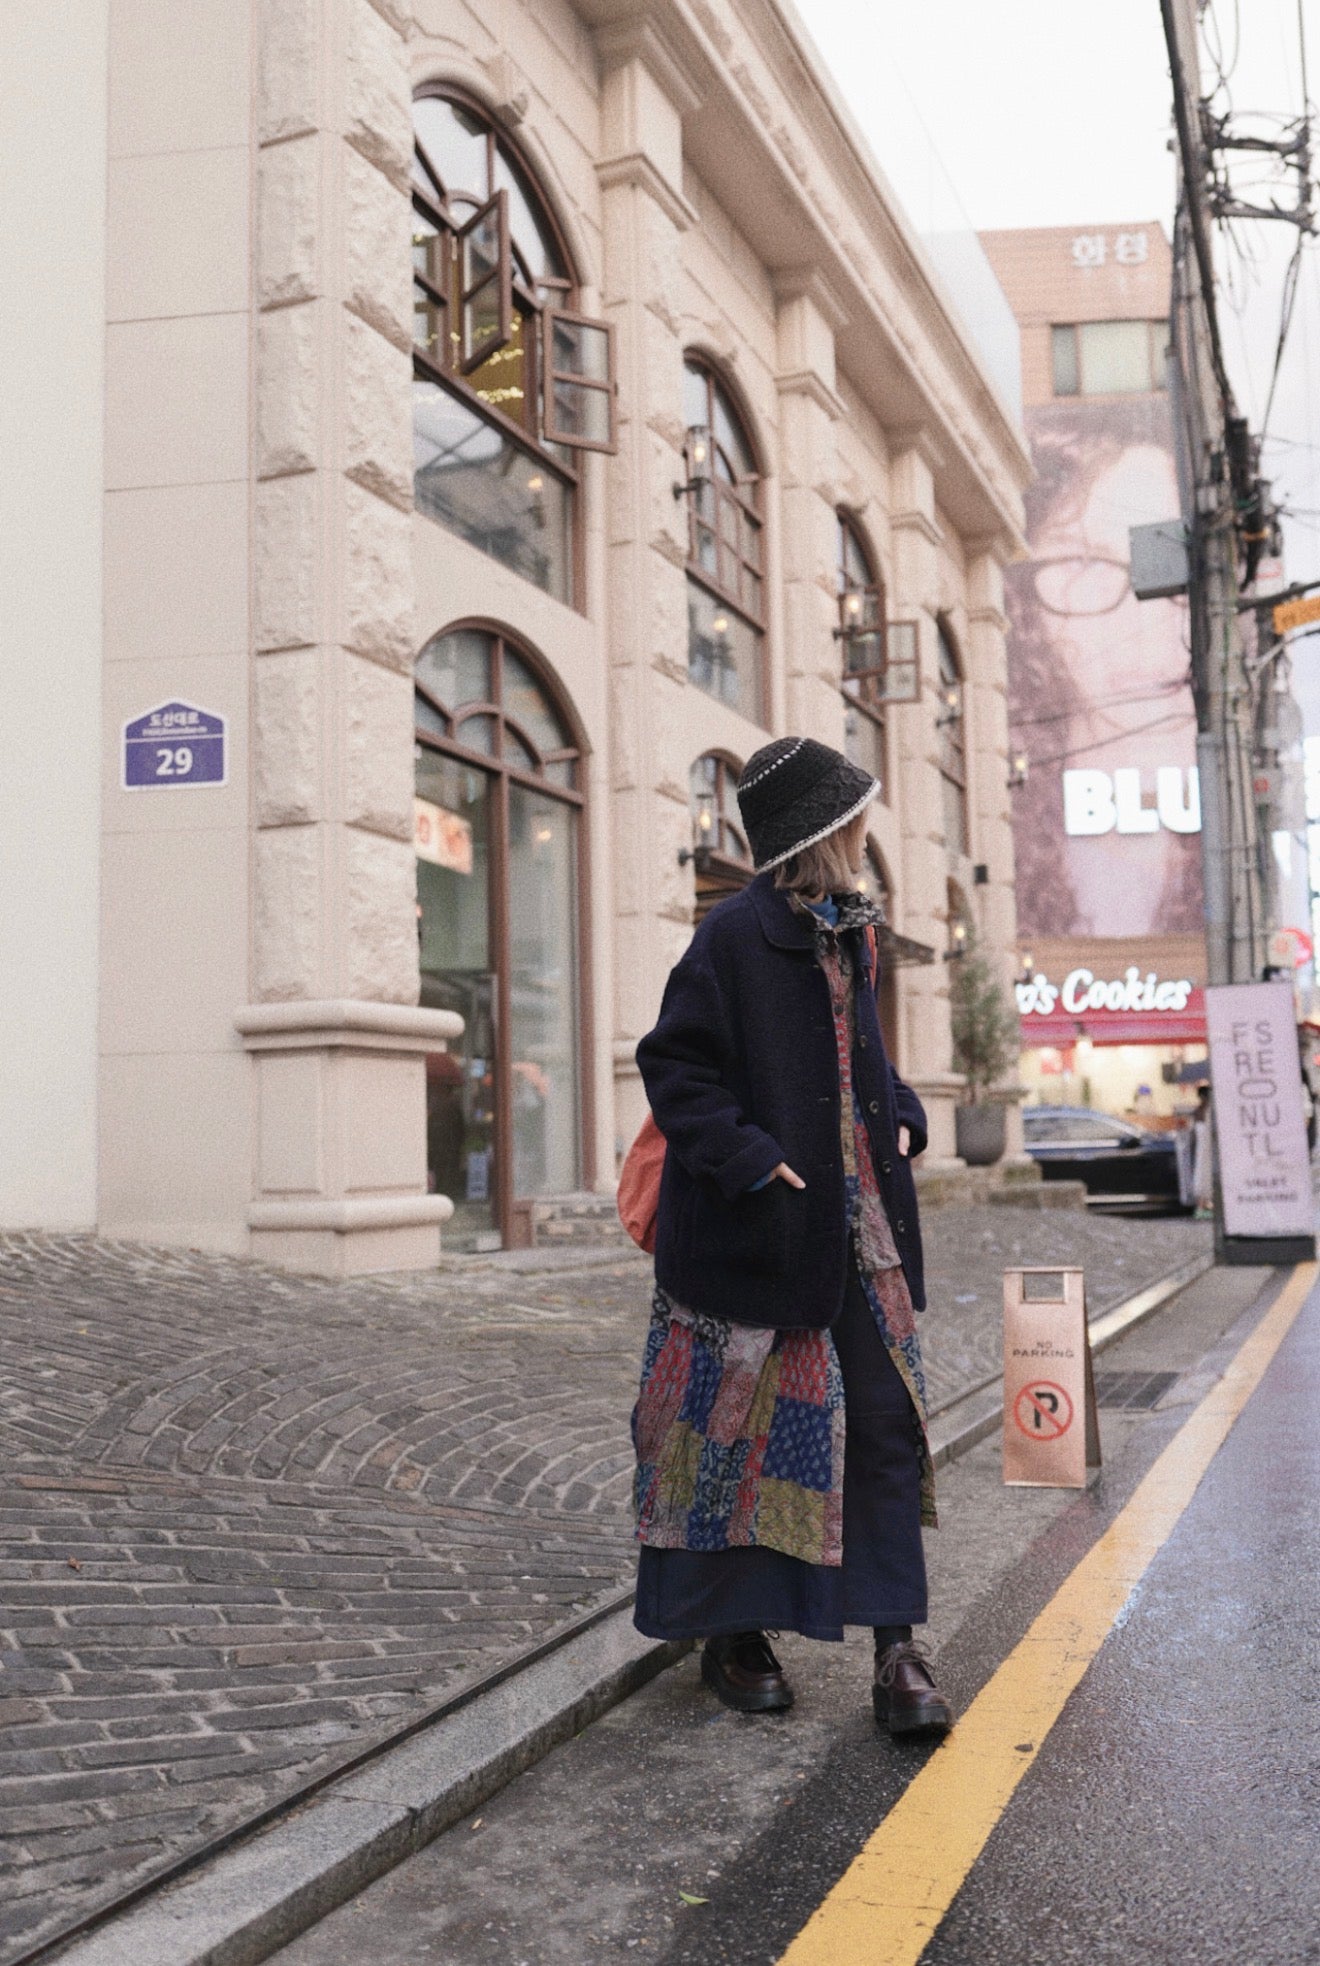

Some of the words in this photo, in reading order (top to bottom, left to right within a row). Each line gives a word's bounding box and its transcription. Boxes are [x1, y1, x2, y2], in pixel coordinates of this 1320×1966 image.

[156, 747, 193, 776] 29
[1063, 766, 1202, 836] BLU
[1062, 966, 1192, 1014] Cookies
[1012, 1349, 1074, 1359] PARKING
[1036, 1341, 1052, 1349] NO
